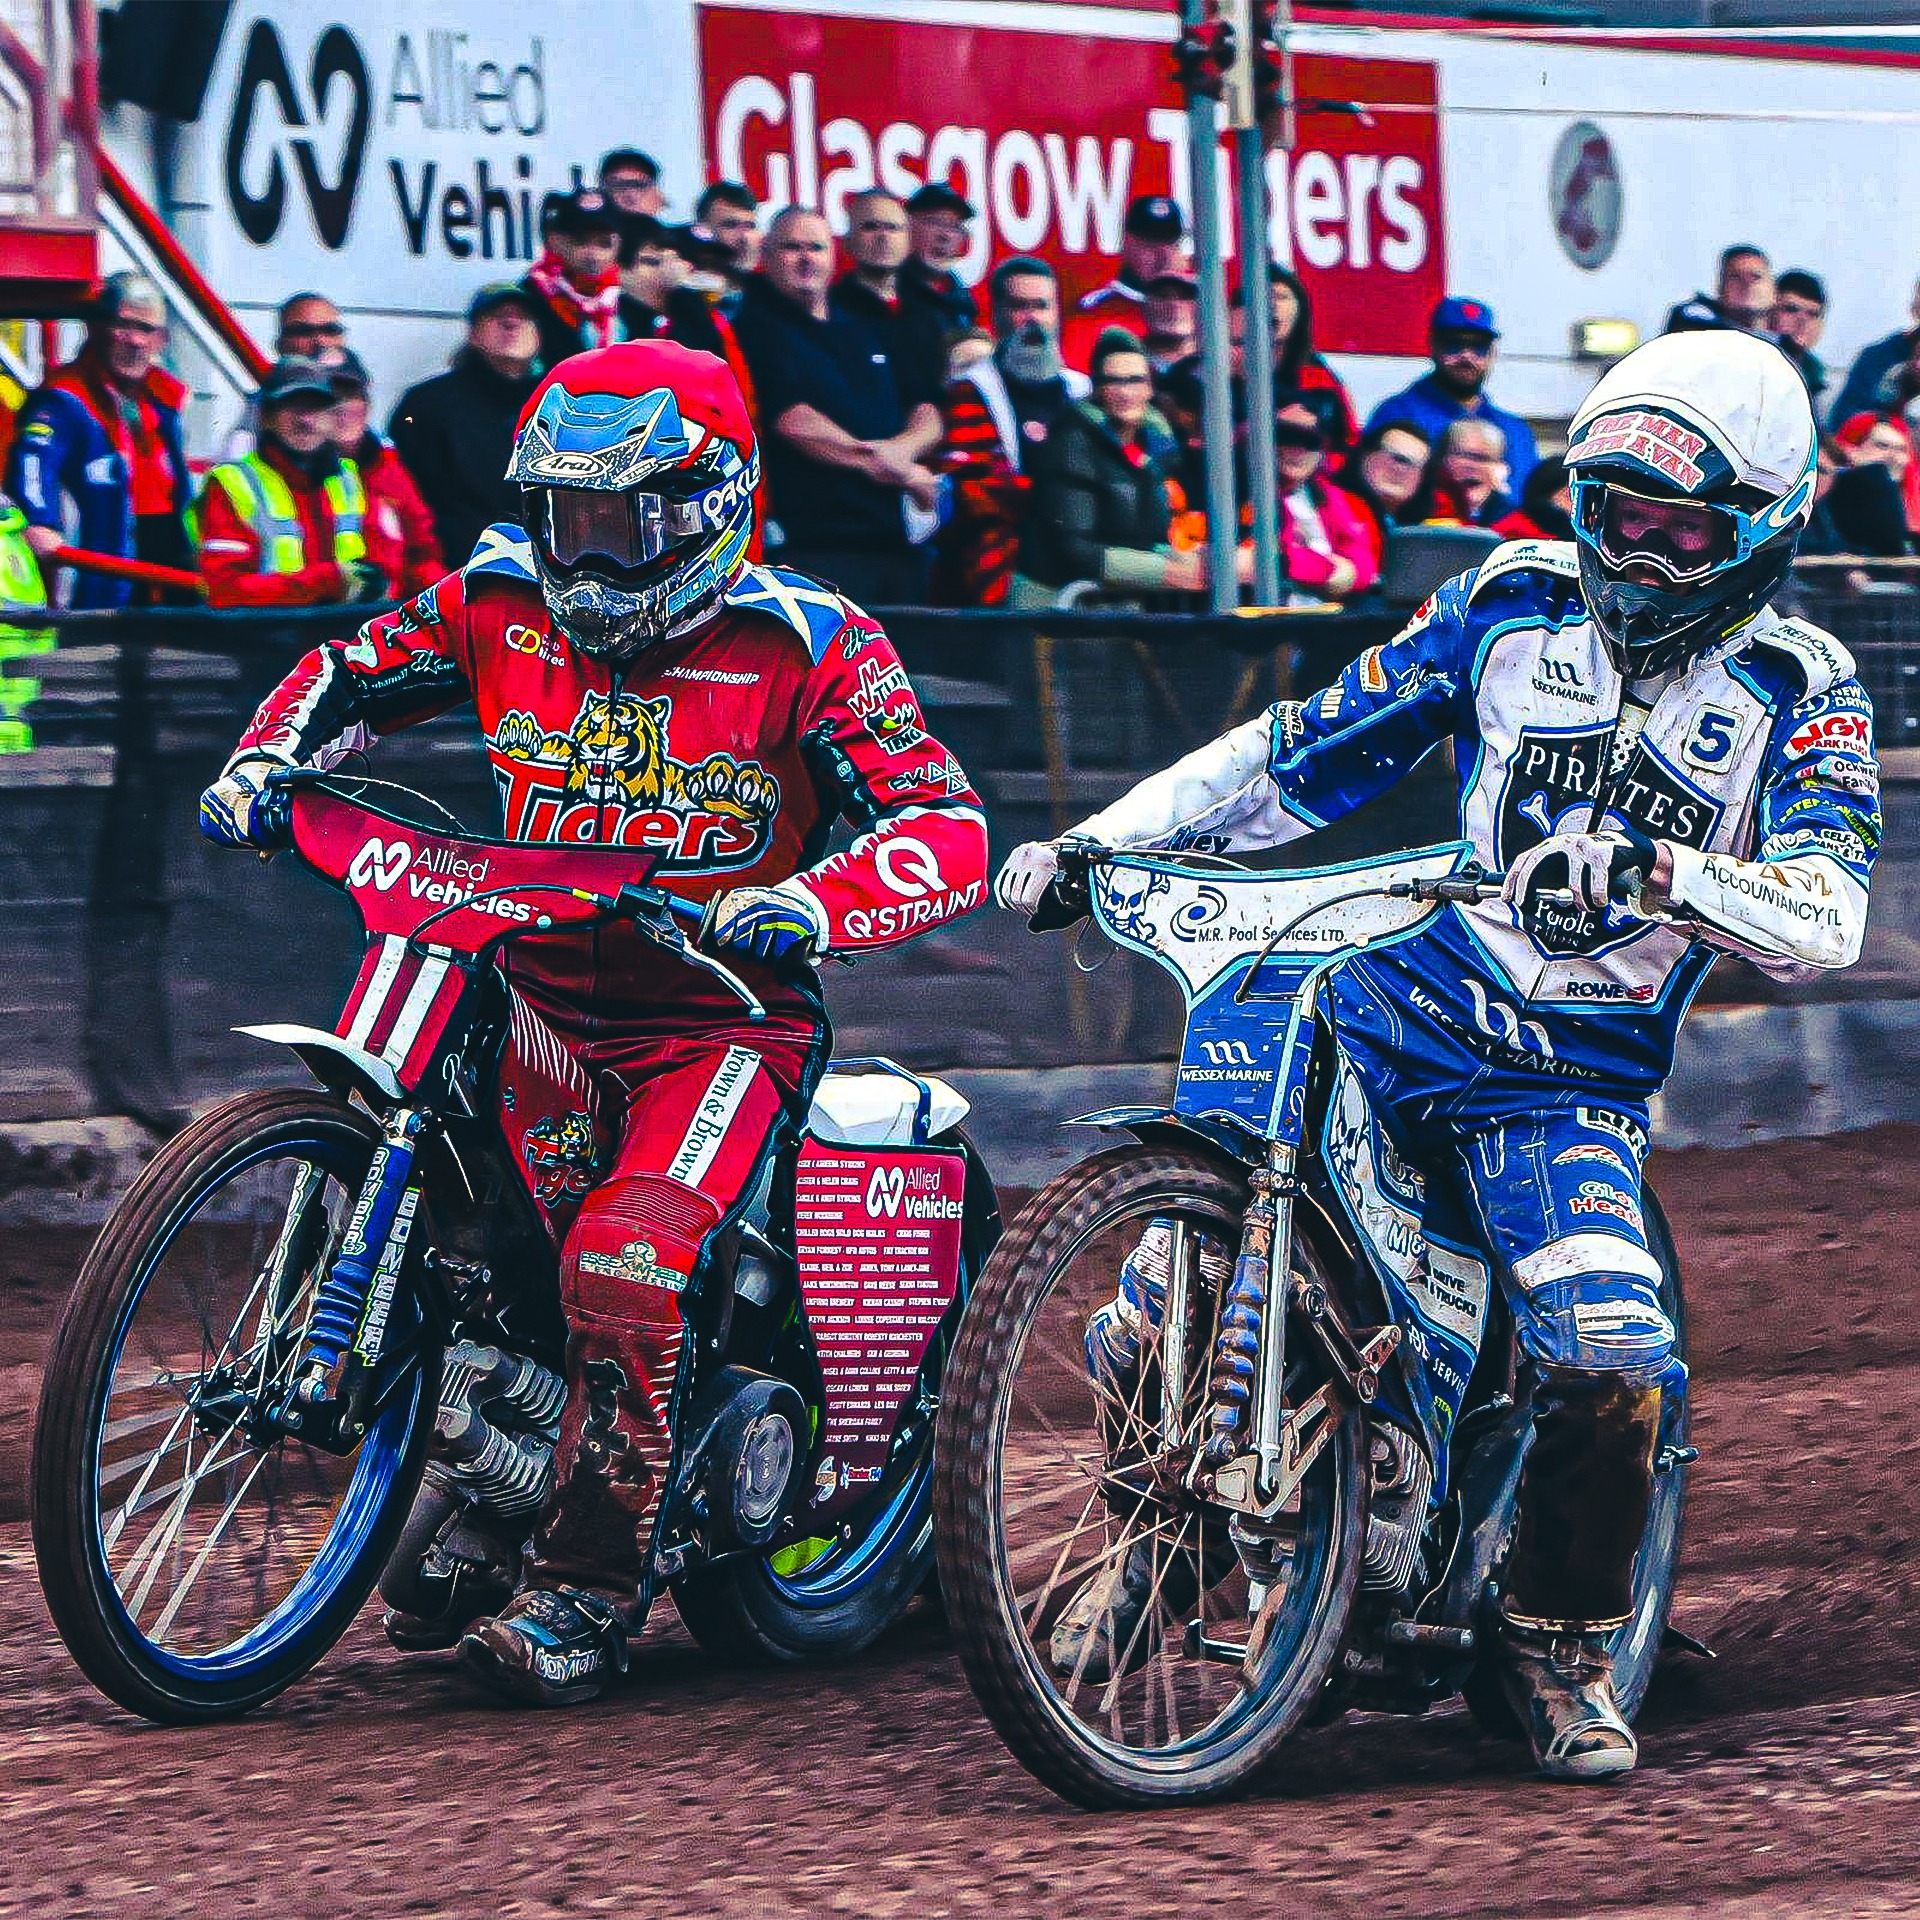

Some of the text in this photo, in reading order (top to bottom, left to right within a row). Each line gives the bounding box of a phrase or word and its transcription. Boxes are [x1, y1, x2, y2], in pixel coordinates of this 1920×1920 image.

[385, 29, 547, 136] Allied
[715, 71, 1134, 289] Glasgow
[1637, 415, 1704, 460] MAN
[533, 457, 596, 477] Arai
[1626, 434, 1650, 457] A
[1652, 442, 1702, 489] VAN
[1556, 686, 1599, 706] MARINE
[1689, 709, 1738, 765] 5
[1523, 743, 1700, 839] PIRATES
[412, 847, 490, 883] Allied
[874, 836, 949, 898] Q
[843, 880, 982, 939] Q'STRAINT
[1701, 858, 1825, 923] ACCOUNTANCY
[1228, 925, 1258, 942] Pool
[1261, 926, 1318, 942] Sevices
[1565, 981, 1624, 999] ROWE
[1181, 1070, 1274, 1082] WESSEX MARINE
[703, 1098, 725, 1118] &
[671, 1115, 724, 1181] Brown
[905, 1167, 941, 1190] Allied
[904, 1194, 963, 1219] Vehicles
